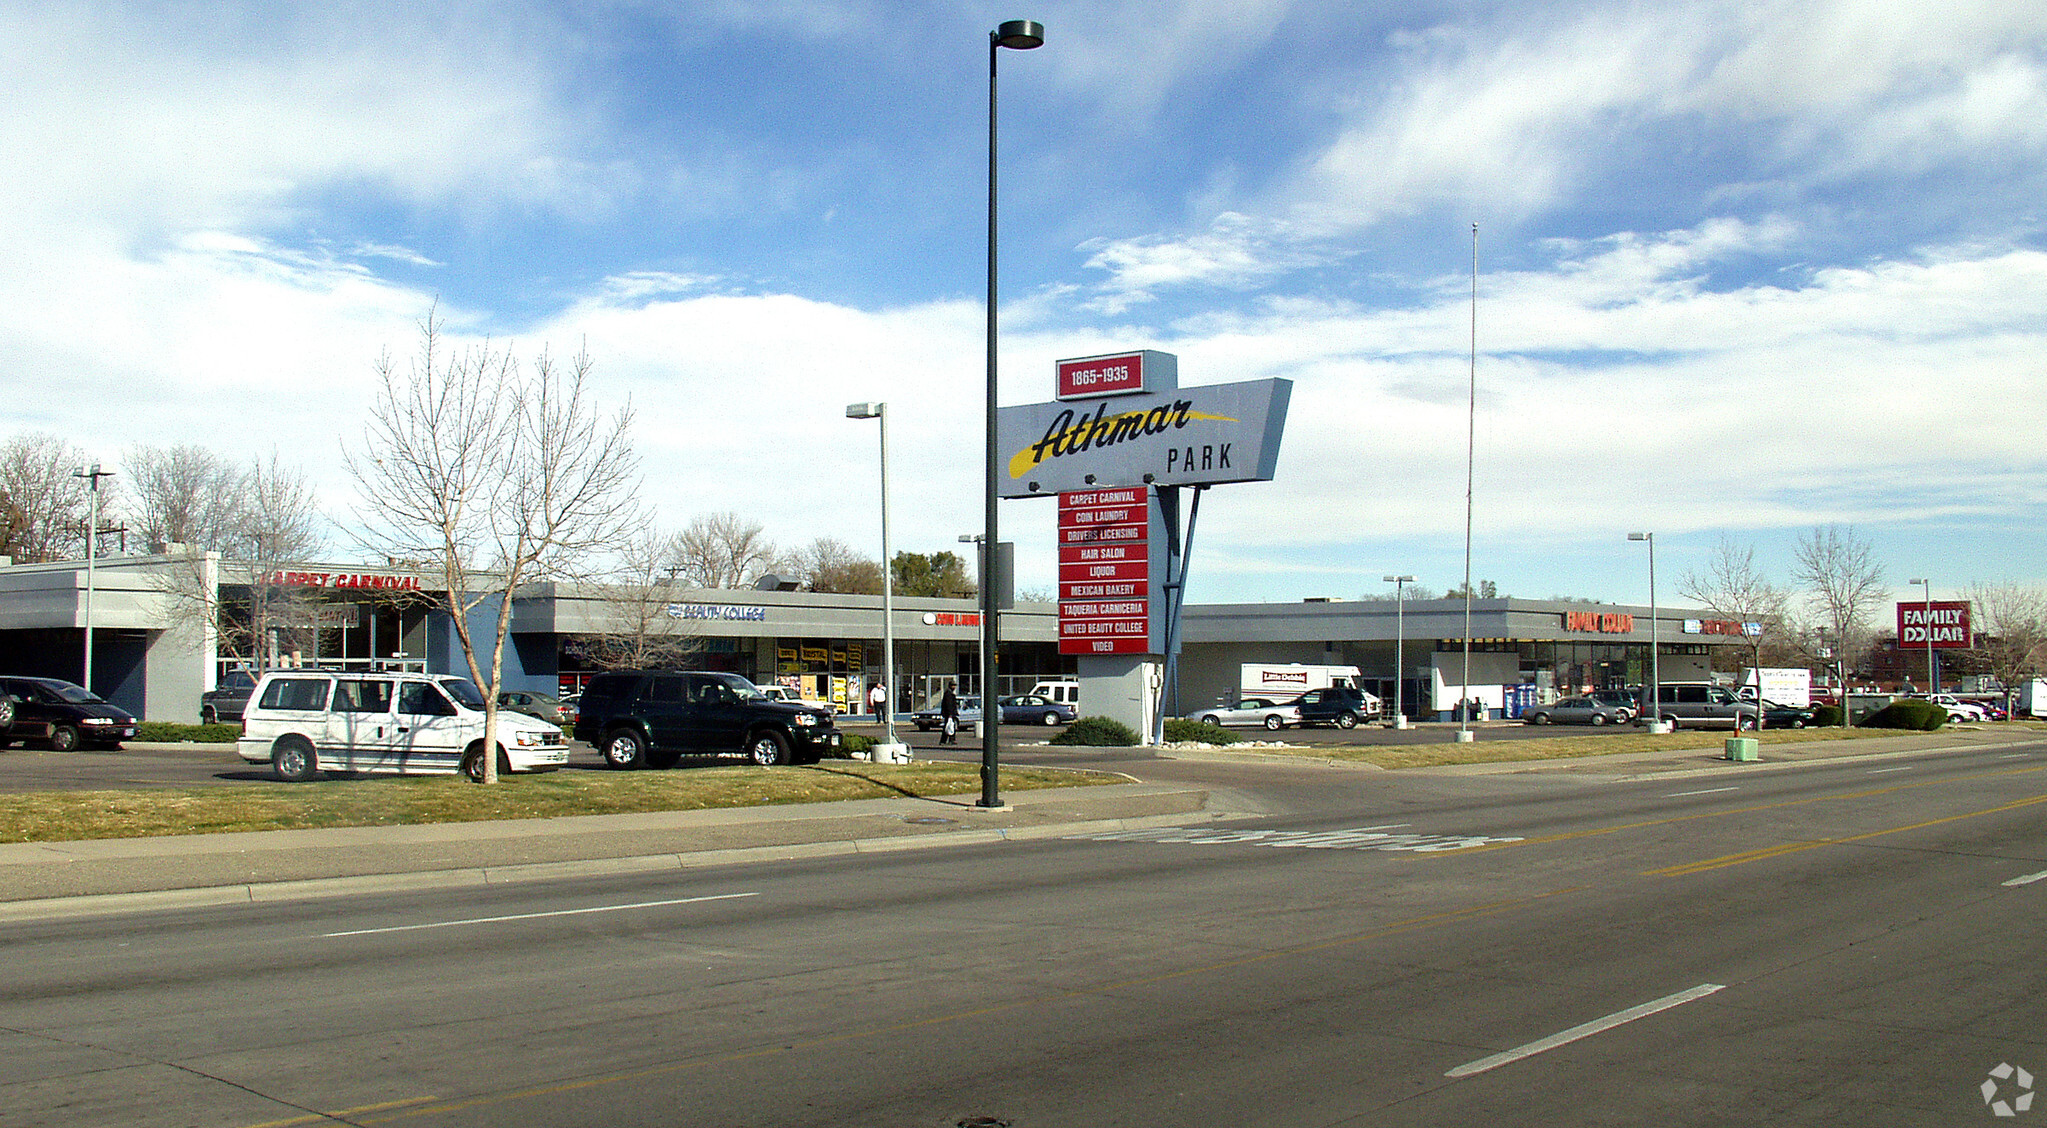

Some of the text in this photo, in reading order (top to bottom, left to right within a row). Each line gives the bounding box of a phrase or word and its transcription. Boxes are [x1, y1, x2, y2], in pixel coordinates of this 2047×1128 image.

[1071, 365, 1129, 386] 1865-1935
[1032, 399, 1192, 463] Athmar
[1166, 443, 1232, 473] PARK
[1069, 491, 1136, 505] CARPET CARNIVAL
[1075, 510, 1129, 523] COIN LAUNDRY
[1100, 528, 1138, 540] LICENSING
[1081, 547, 1125, 560] HAIR SALON
[1089, 566, 1116, 578] LIQUOR
[335, 574, 422, 590] CARNIVAL
[1070, 584, 1135, 596] MEXICAN BAKERY
[684, 605, 722, 619] BEAUTY
[723, 606, 765, 620] COLLEGE
[1903, 609, 1962, 625] FAMILY
[1063, 622, 1143, 634] UNITED BEAUTY COLLEGE
[1903, 626, 1964, 643] DOLLAR
[1092, 641, 1114, 652] VIDEO
